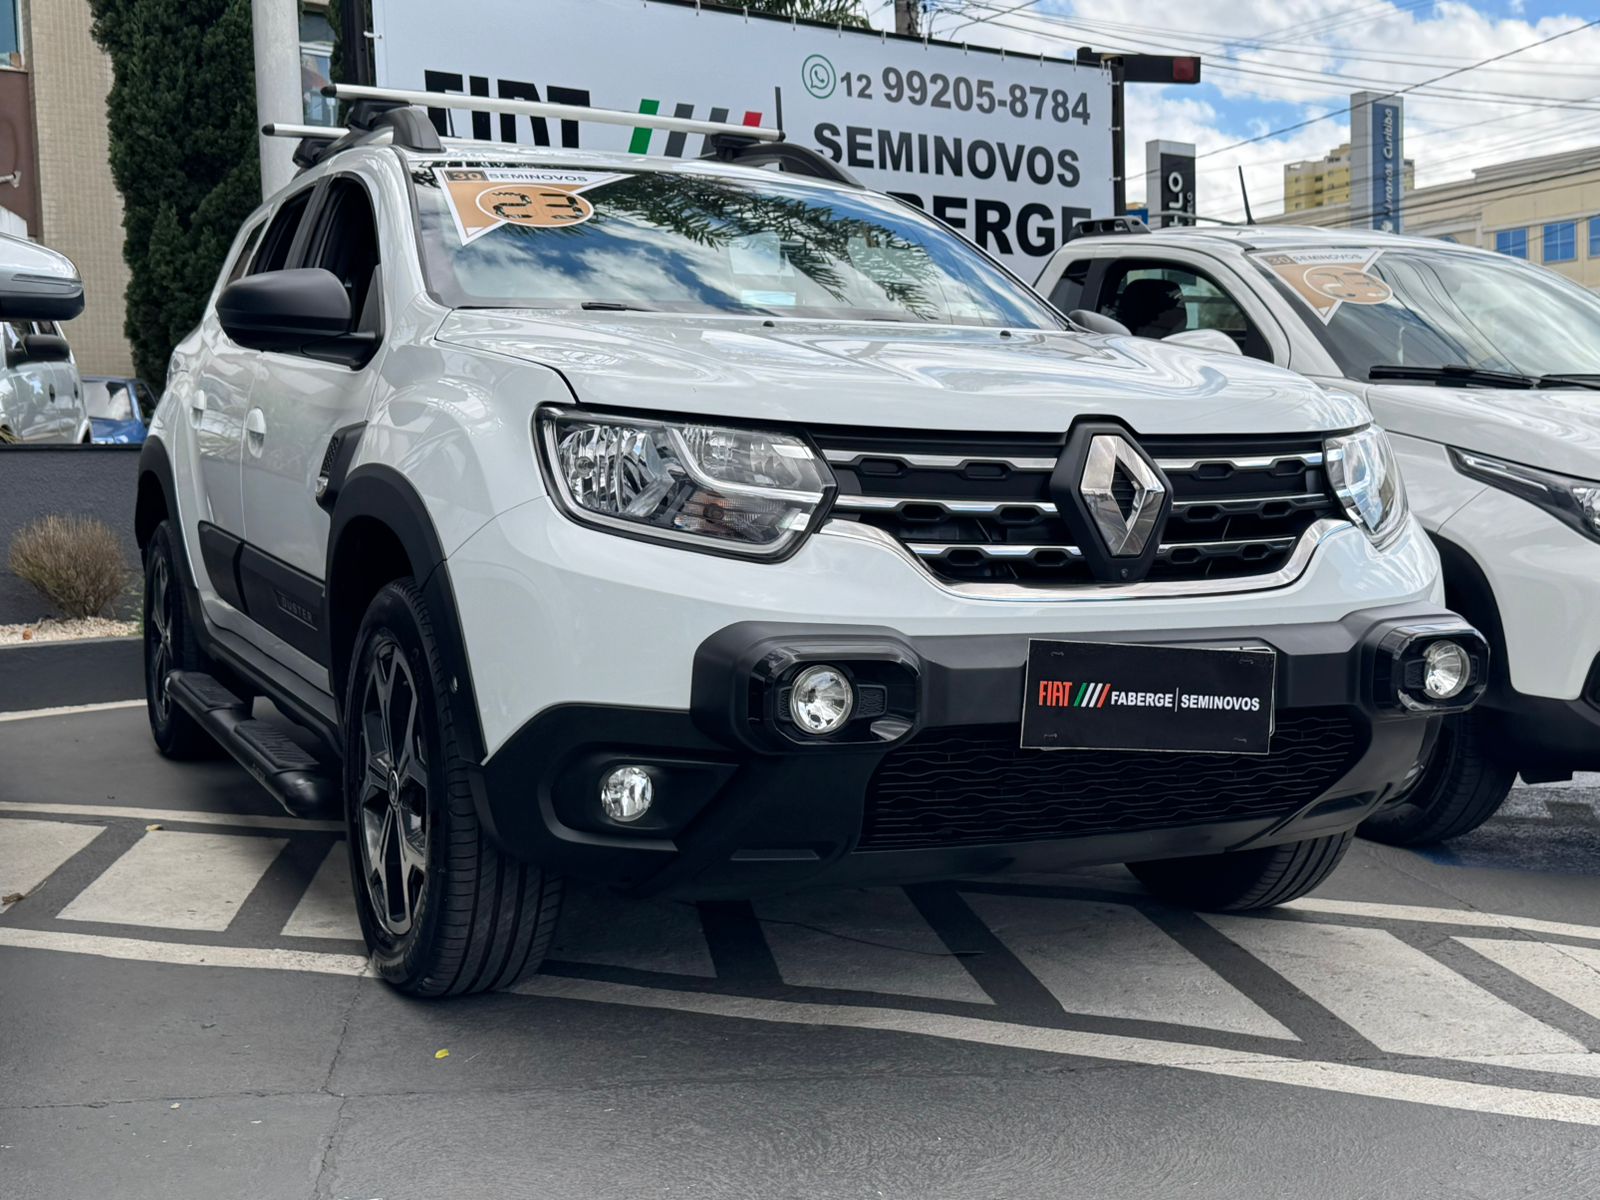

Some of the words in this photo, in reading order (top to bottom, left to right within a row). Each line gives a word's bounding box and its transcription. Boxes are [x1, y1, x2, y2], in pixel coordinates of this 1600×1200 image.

[424, 69, 591, 149] FIAT
[840, 72, 873, 100] 12
[882, 66, 1091, 126] 99205-8784
[813, 122, 1081, 188] SEMINOVOS
[1383, 108, 1393, 159] Curitiba
[489, 173, 589, 182] SEMINOVOS
[1038, 681, 1072, 707] FIAT
[1111, 691, 1174, 707] FABERGE
[1181, 694, 1260, 711] SEMINOVOS
